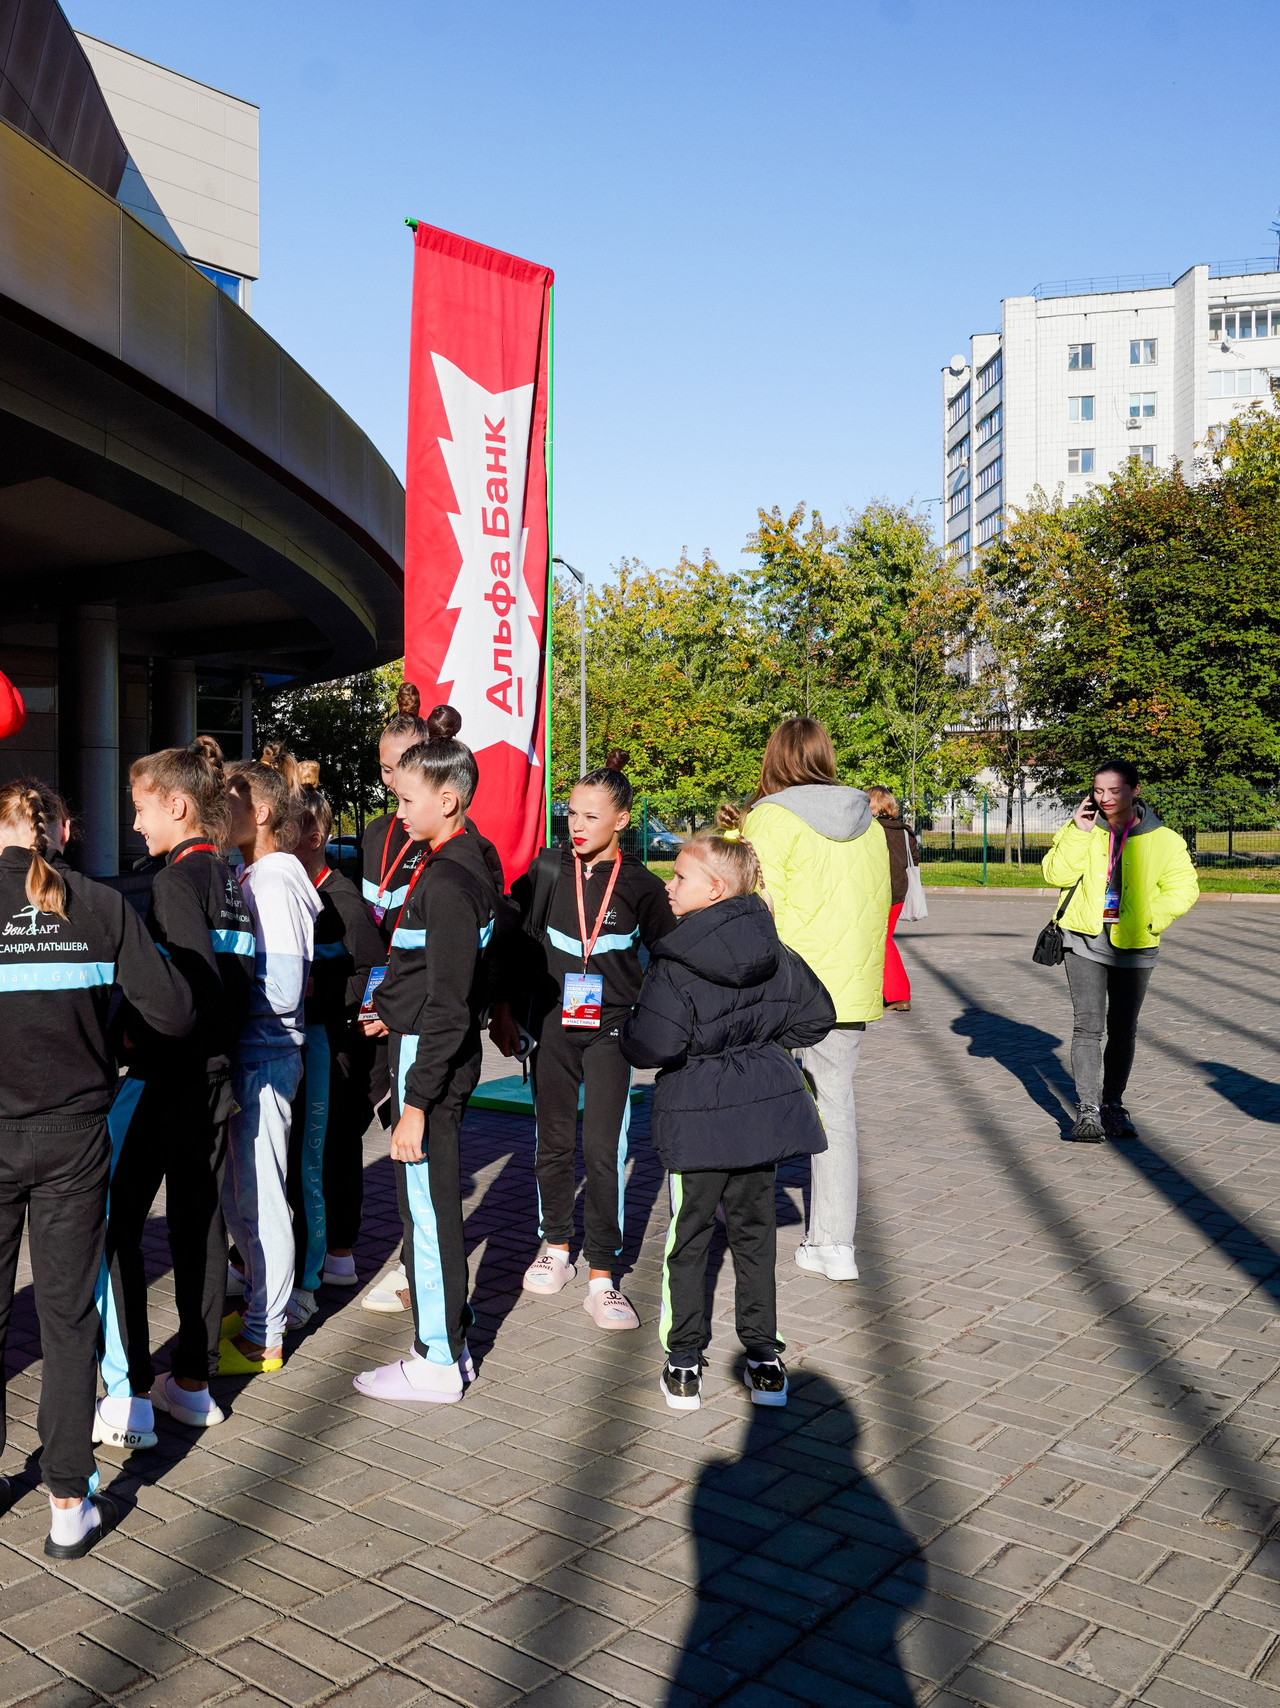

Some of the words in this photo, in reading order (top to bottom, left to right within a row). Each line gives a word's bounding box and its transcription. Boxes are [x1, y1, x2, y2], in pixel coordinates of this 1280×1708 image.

[481, 414, 511, 538] Банк
[484, 551, 518, 716] Альфа
[36, 941, 89, 952] ЛАТЫШЕВА
[307, 1100, 326, 1239] eviart.GYM
[530, 1264, 554, 1272] CHANEL
[603, 1300, 629, 1308] CHANEL
[112, 1432, 142, 1446] OMG!
